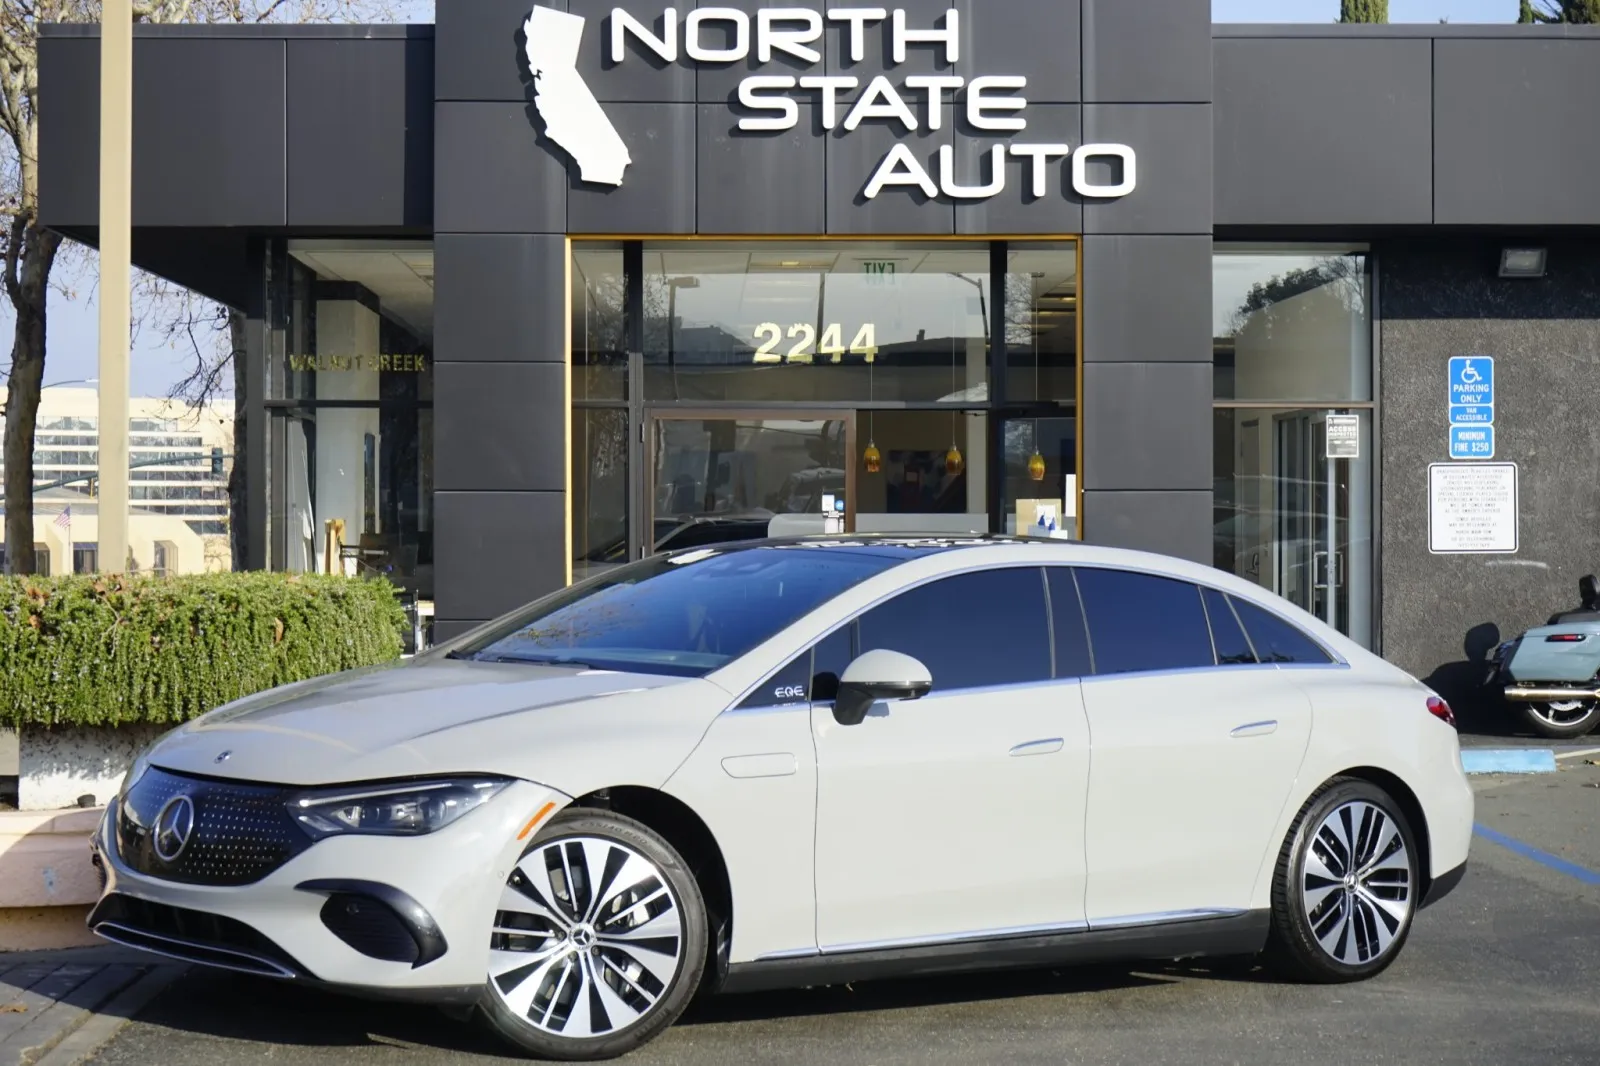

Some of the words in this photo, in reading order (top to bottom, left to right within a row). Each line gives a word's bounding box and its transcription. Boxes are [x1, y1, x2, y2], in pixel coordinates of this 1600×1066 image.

[612, 8, 958, 62] NORTH
[739, 76, 1026, 130] STATE
[865, 144, 1136, 198] AUTO
[752, 322, 879, 364] 2244
[289, 354, 364, 372] WALNUT
[368, 354, 425, 372] CREEK
[1453, 384, 1489, 393] PARKING
[1460, 394, 1482, 403] ONLY
[1458, 431, 1485, 441] MINIMUM
[1454, 442, 1469, 452] FINE
[1471, 441, 1490, 452] $250
[774, 686, 805, 698] EQE
